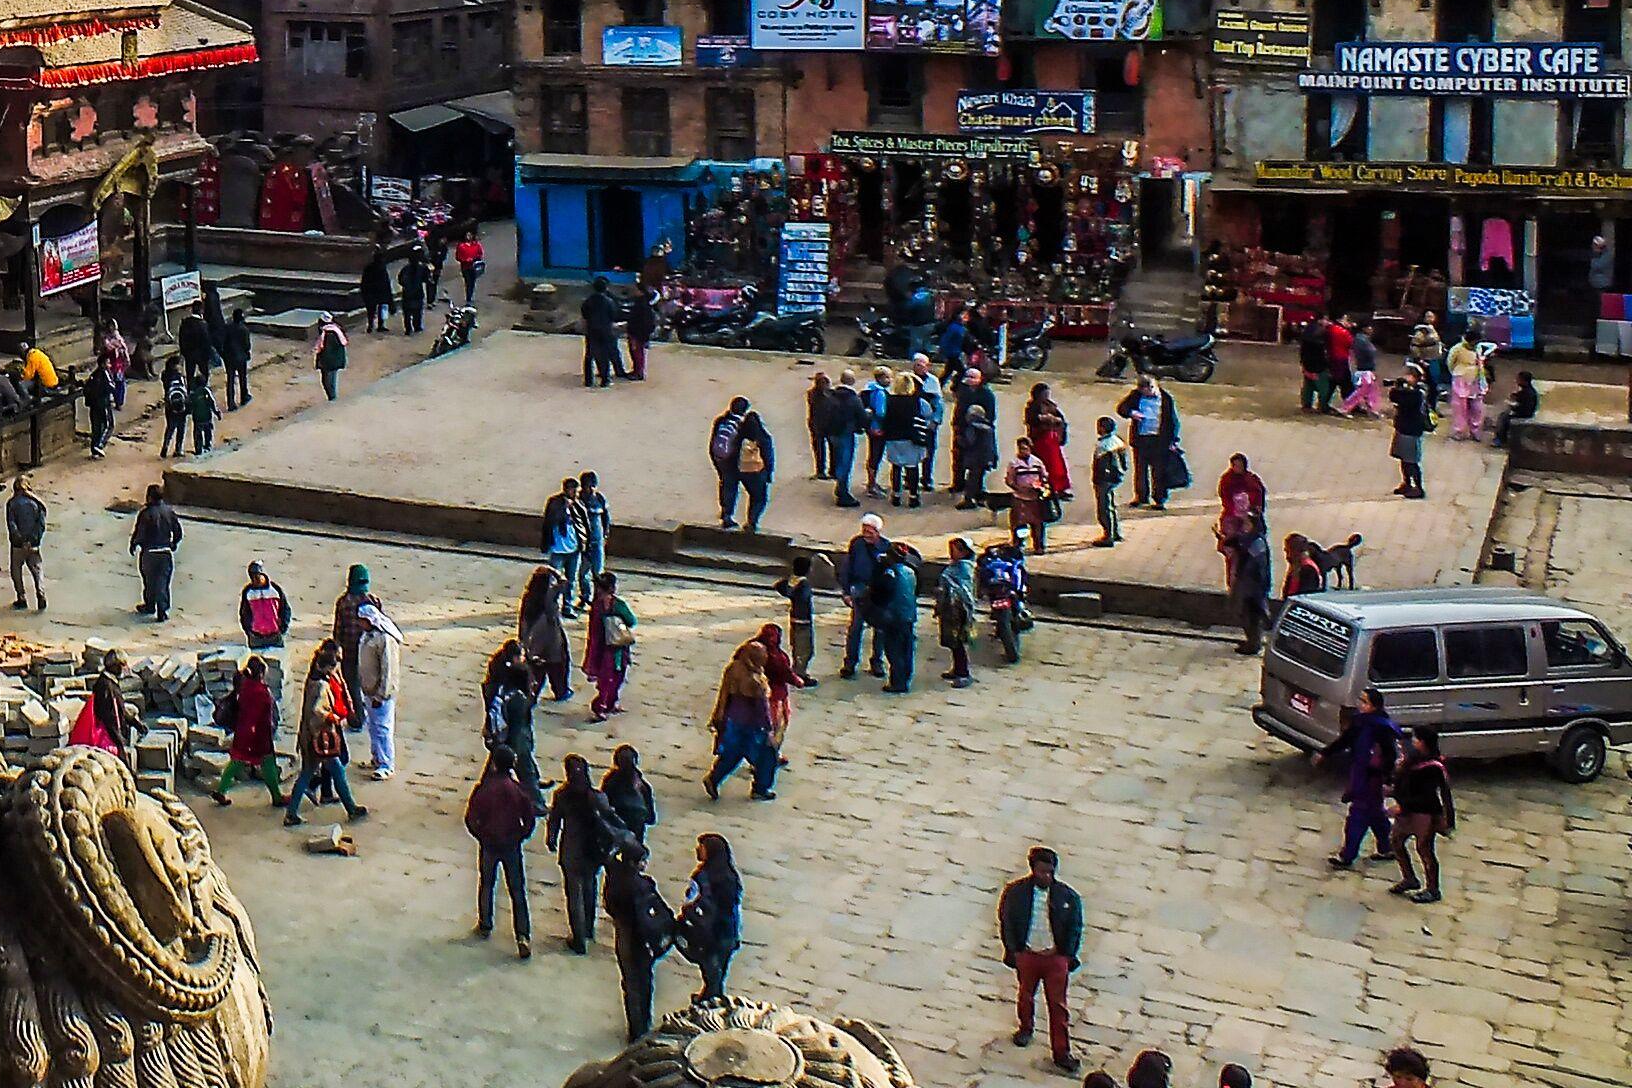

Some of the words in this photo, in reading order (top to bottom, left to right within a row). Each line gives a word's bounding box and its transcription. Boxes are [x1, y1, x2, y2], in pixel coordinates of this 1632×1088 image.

[756, 11, 799, 19] COSY
[806, 11, 858, 19] HOTEL
[1341, 47, 1450, 73] NAMASTE
[1456, 47, 1533, 75] CYBER
[1539, 47, 1599, 75] CAFE
[1298, 74, 1406, 90] MAINPOINT
[1409, 77, 1518, 92] COMPUTER
[1522, 78, 1626, 93] INSTITUTE
[957, 93, 999, 113] Newari
[1002, 93, 1036, 108] Khaja
[852, 136, 884, 150] Spices
[886, 137, 895, 148] &
[897, 138, 934, 150] Master
[936, 138, 968, 151] Pieces
[1319, 164, 1352, 179] Wood
[1357, 164, 1403, 183] Carving
[1407, 165, 1447, 180] Store
[1455, 168, 1499, 187] Pagoda
[1575, 172, 1586, 187] &
[1291, 606, 1350, 635] SPORTS
